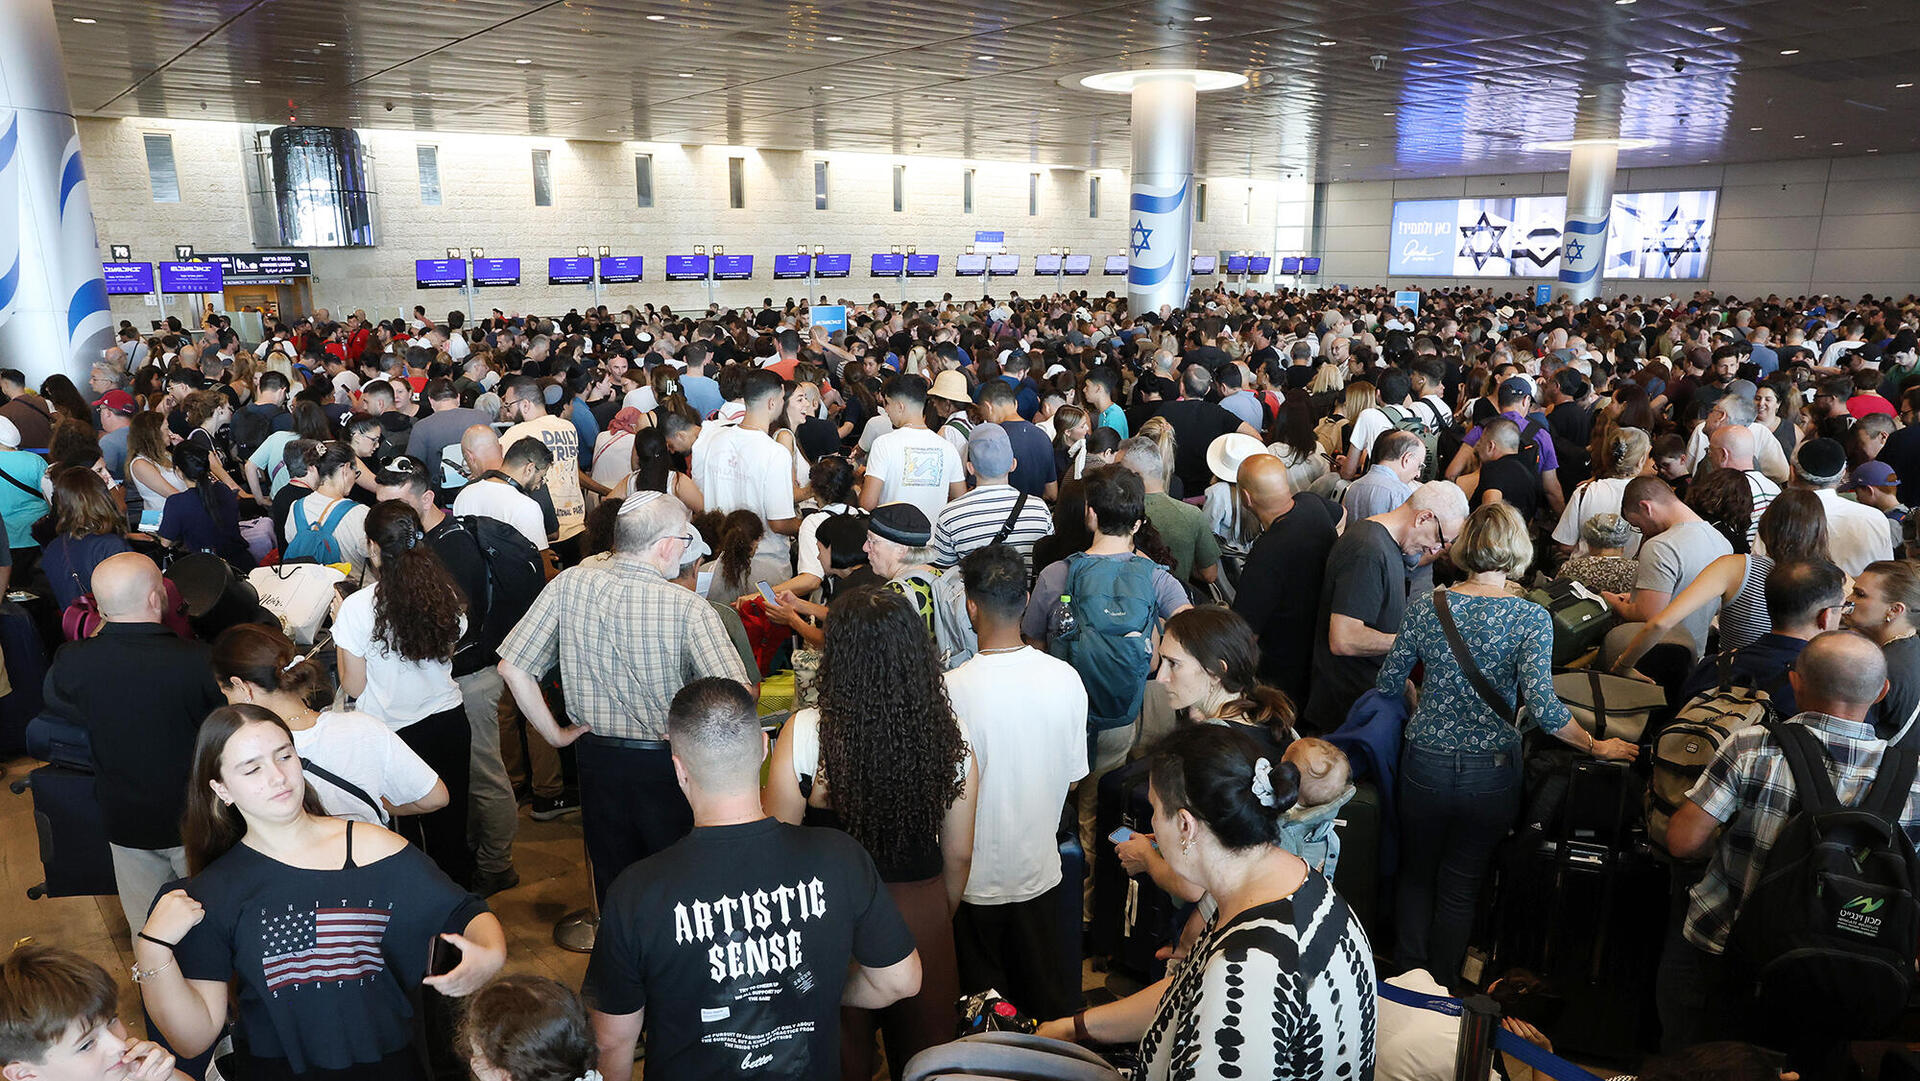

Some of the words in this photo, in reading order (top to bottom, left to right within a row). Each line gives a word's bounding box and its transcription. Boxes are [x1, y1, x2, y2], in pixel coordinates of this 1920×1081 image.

[113, 246, 129, 257] 76
[178, 246, 191, 257] 77
[471, 248, 484, 258] 79
[599, 246, 609, 256] 81
[541, 430, 577, 445] DAILY
[673, 876, 827, 946] ARTISTIC
[1864, 916, 1881, 926] מכון
[708, 929, 802, 984] SENSE
[772, 1027, 799, 1036] PRACTICE
[781, 1023, 796, 1031] ONLY
[769, 1034, 793, 1043] OUTSIDE
[741, 1052, 774, 1069] better
